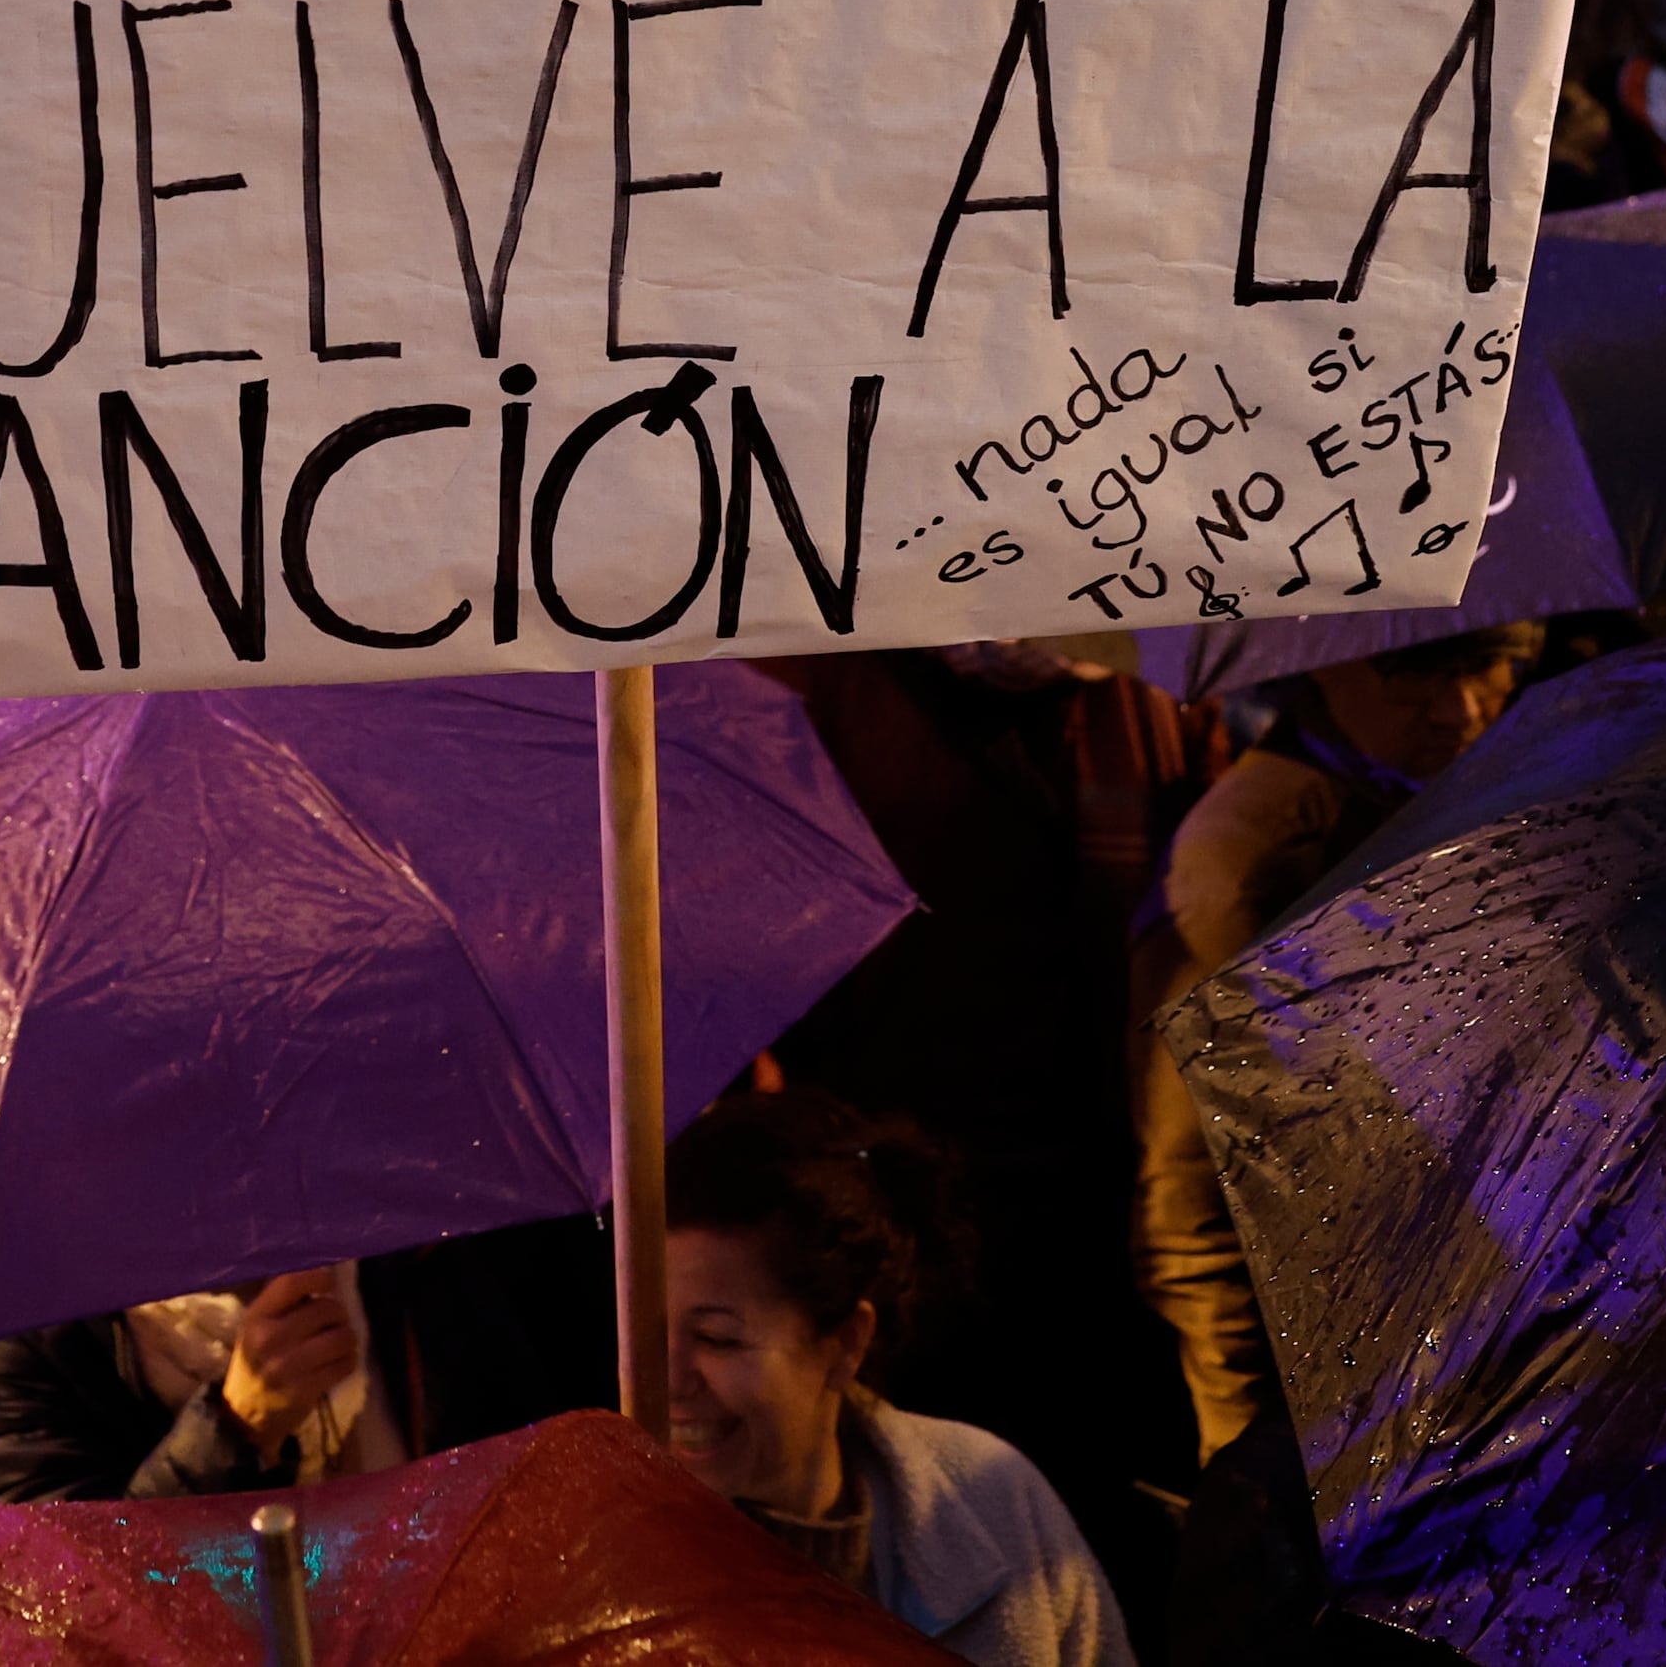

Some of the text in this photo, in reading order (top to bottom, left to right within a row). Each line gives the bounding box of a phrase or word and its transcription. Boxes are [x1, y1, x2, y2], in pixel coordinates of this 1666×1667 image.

[937, 328, 1376, 584] es igual si
[1068, 548, 1168, 620] TÚ
[1196, 471, 1285, 565] NO
